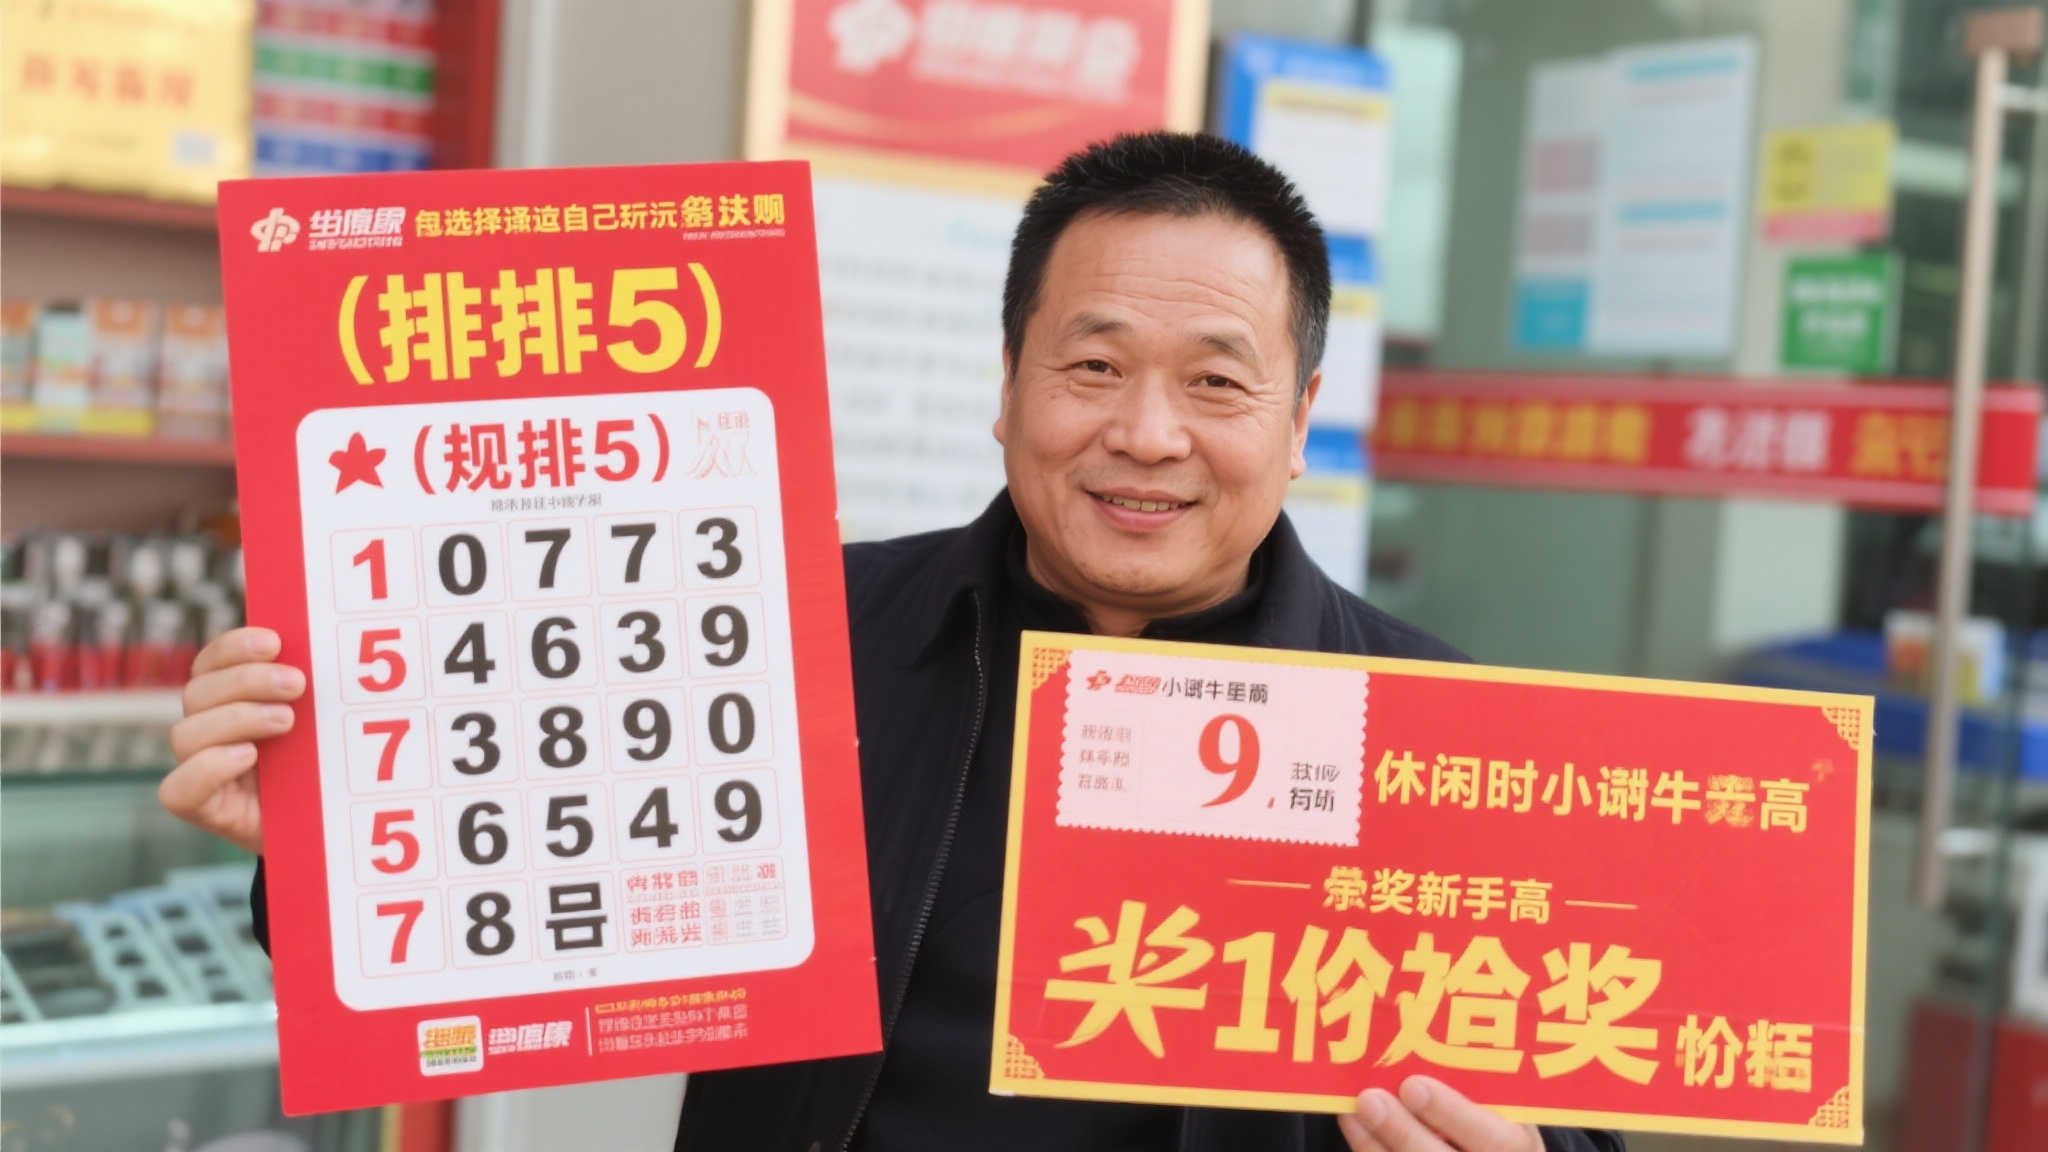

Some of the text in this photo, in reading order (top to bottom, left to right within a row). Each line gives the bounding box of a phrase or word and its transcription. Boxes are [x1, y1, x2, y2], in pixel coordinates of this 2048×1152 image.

[354, 518, 741, 600] 1 0 7 7 3
[359, 606, 748, 692] 5 4 6 3 9
[363, 694, 754, 781] 7 3 8 9 0
[372, 781, 761, 873] 5 6 5 4 9
[377, 901, 424, 963] 7
[466, 893, 514, 955] 8
